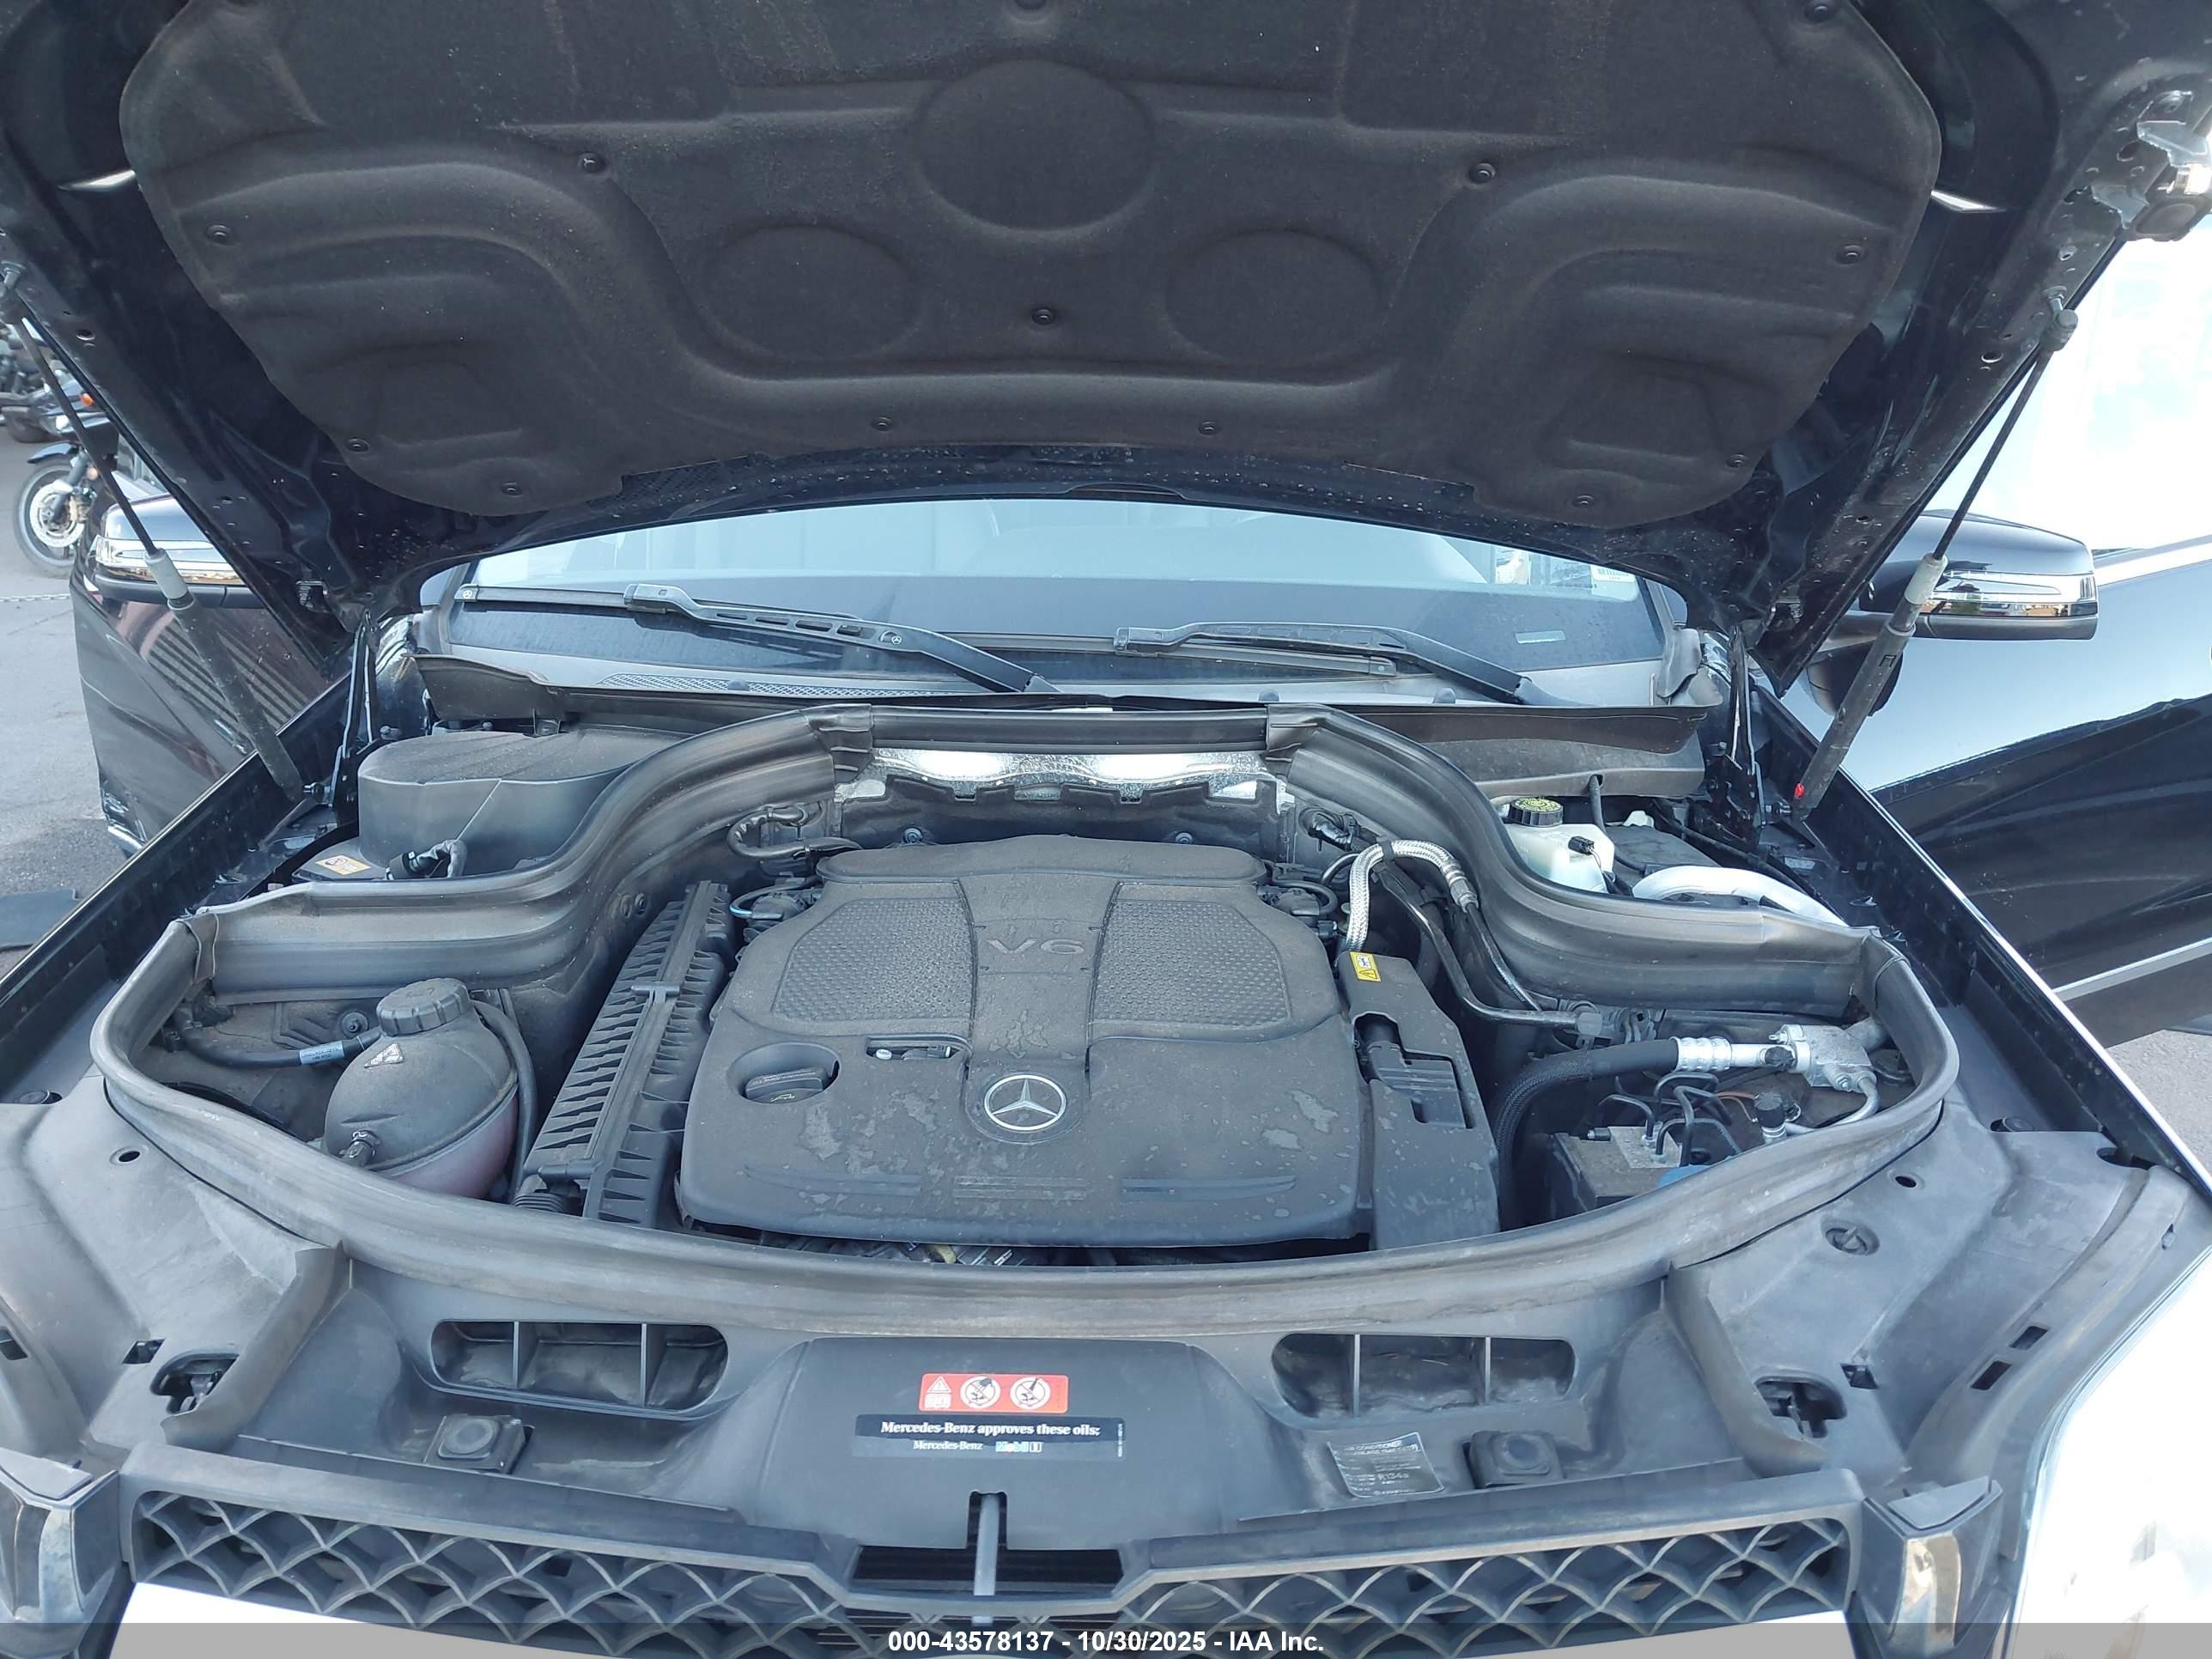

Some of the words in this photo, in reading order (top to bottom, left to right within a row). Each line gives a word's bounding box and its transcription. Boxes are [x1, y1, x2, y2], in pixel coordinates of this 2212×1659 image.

[988, 939, 1085, 955] V6
[880, 1421, 975, 1434] Mercedes-Benz
[977, 1425, 1035, 1437] approves
[1036, 1423, 1072, 1435] these
[913, 1440, 983, 1450] Mercedes-Benz
